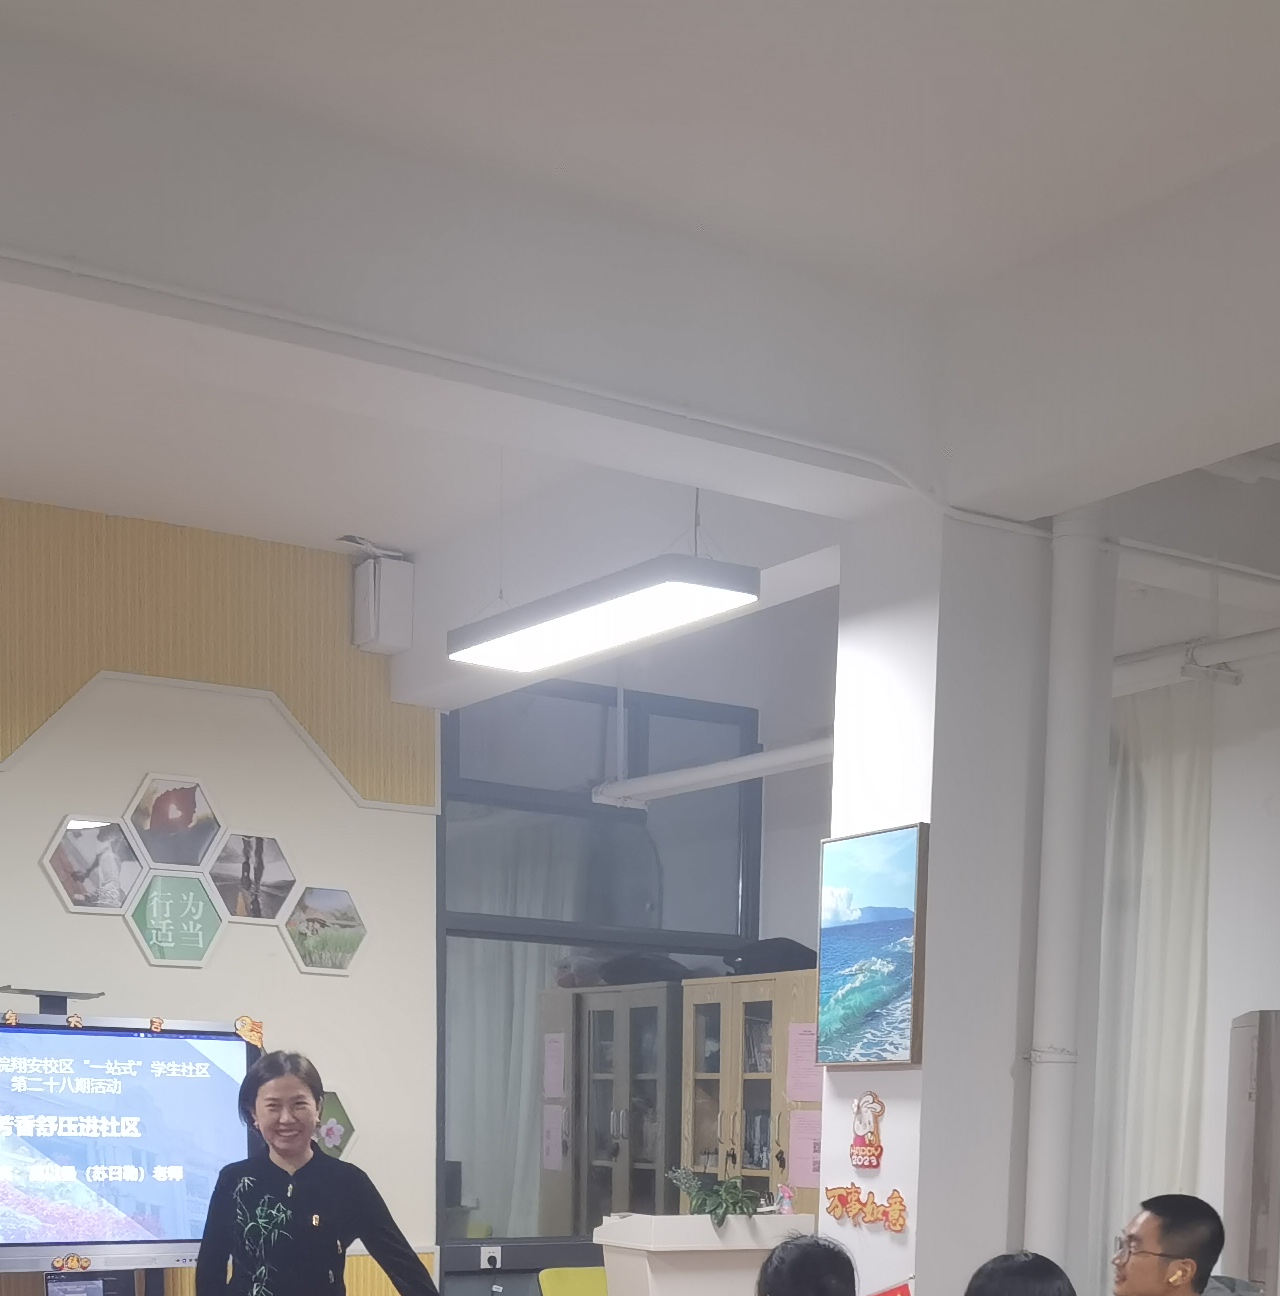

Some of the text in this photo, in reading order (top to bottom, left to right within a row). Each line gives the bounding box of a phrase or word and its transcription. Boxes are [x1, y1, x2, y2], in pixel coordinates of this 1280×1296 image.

[147, 890, 205, 922] 行为
[147, 919, 205, 949] 适当
[11, 1077, 122, 1095] 第二十八期活动
[852, 1156, 878, 1166] 2023
[825, 1181, 908, 1233] 万事如意
